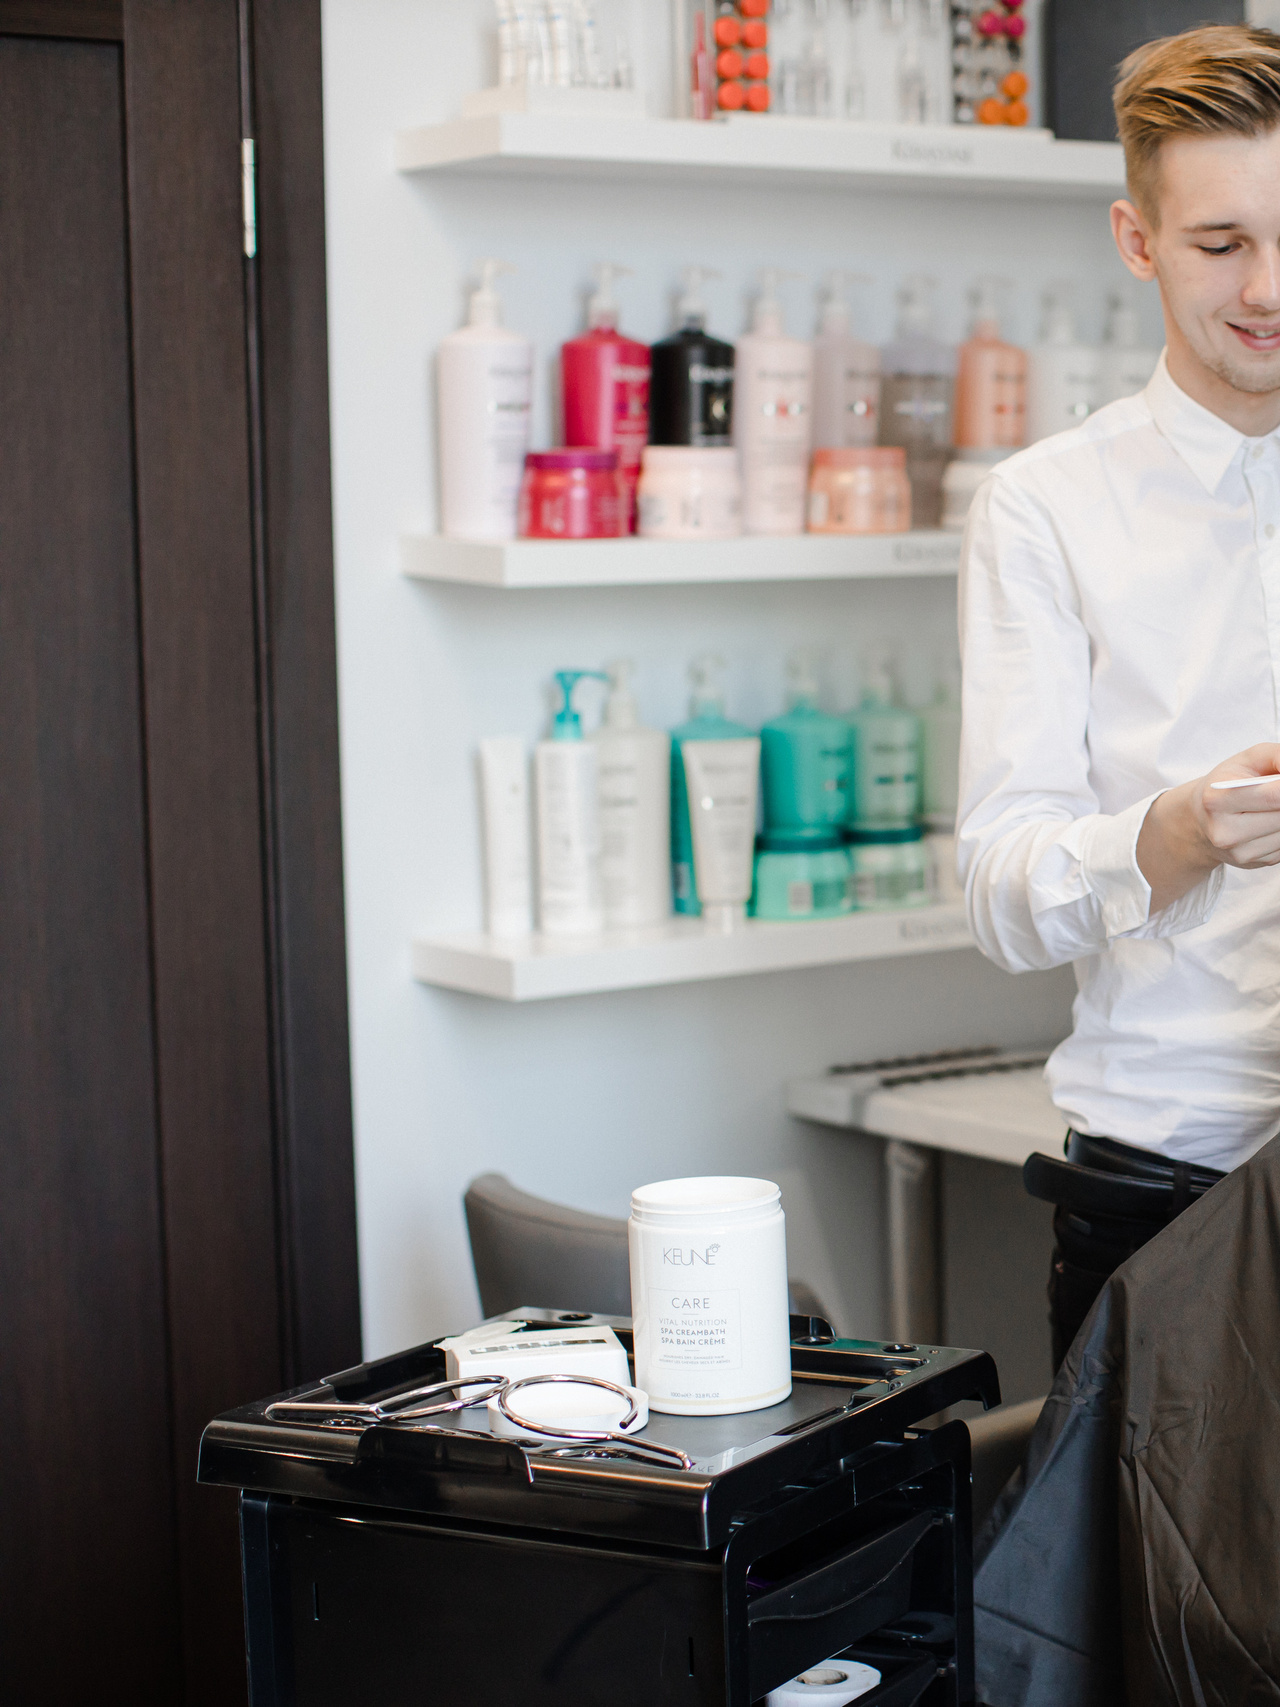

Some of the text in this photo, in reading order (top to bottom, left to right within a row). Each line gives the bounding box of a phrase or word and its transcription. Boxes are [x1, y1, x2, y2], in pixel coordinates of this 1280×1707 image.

[662, 1244, 721, 1266] KEUNE
[671, 1297, 711, 1309] CARE
[659, 1317, 727, 1326] VITAL NUTRITION
[660, 1327, 726, 1336] SPA CREAMBATH
[661, 1336, 675, 1344] SPA
[697, 1336, 726, 1345] CRÈME
